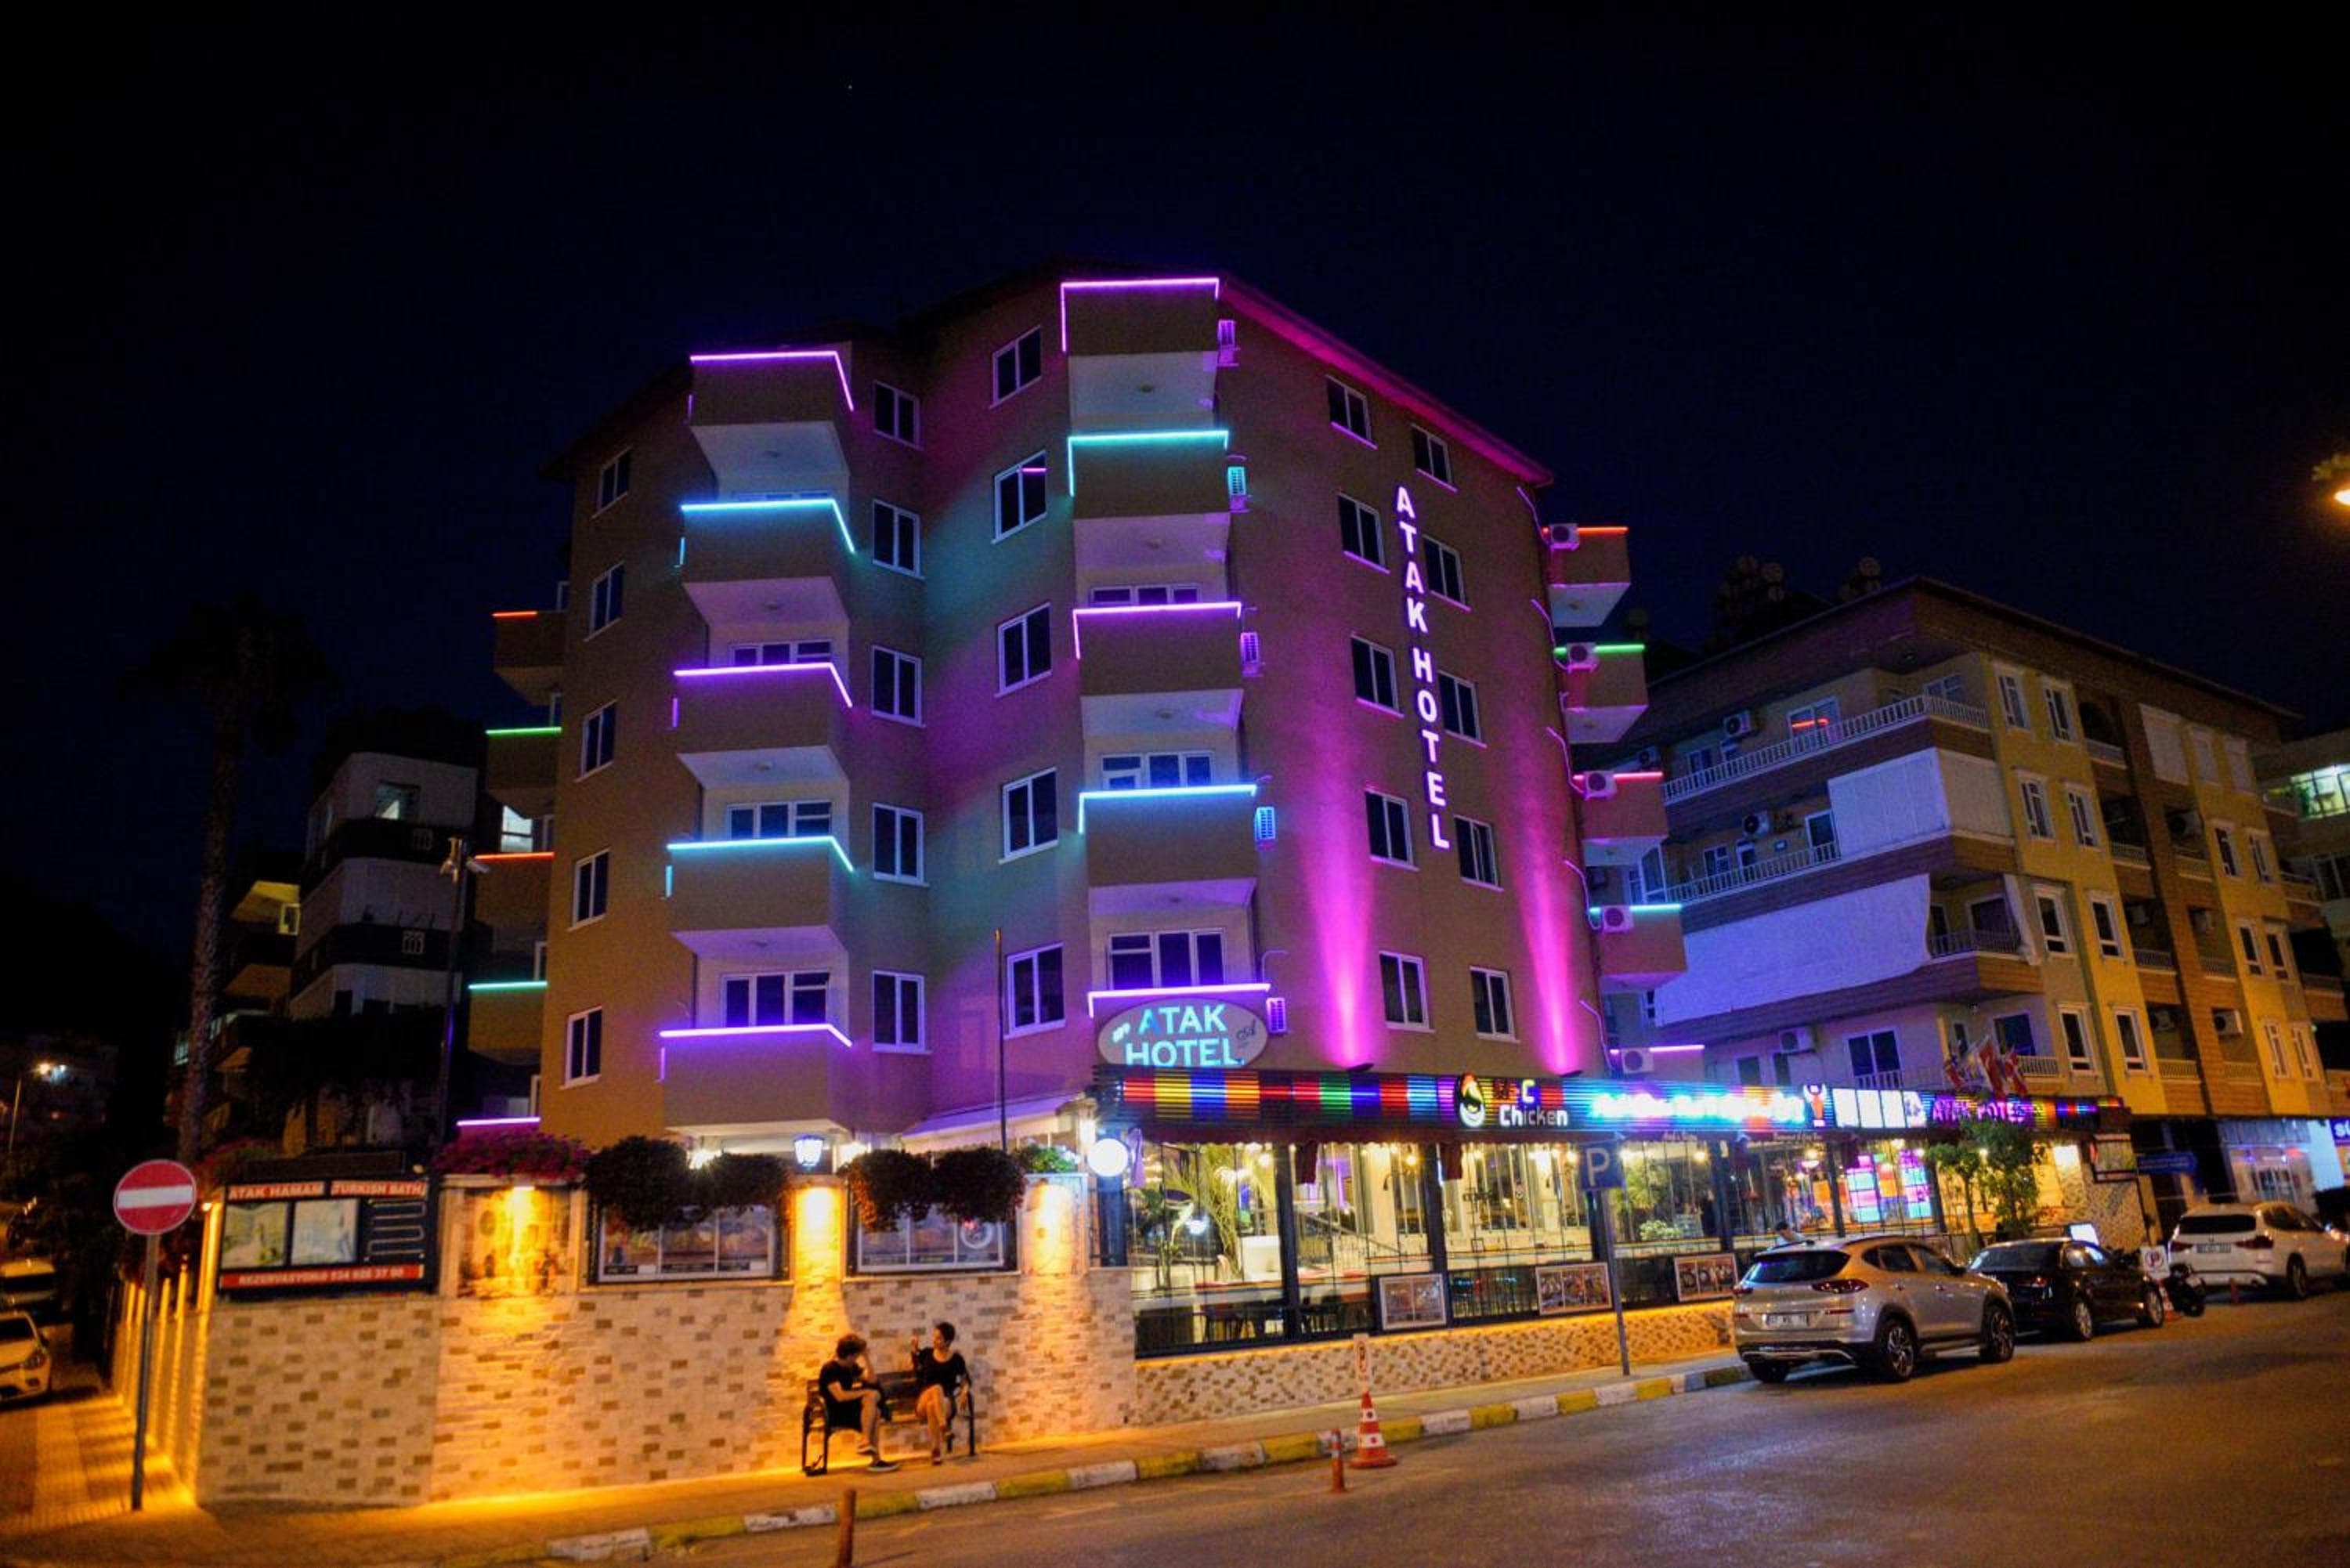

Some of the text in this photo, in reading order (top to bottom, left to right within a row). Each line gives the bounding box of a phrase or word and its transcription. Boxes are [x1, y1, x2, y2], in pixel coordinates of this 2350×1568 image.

[1397, 486, 1450, 850] ATAK HOTEL
[1138, 1004, 1227, 1035] ATAK
[1125, 1039, 1246, 1068] HOTEL
[1499, 1104, 1569, 1126] Chicken
[1586, 1147, 1610, 1187] P
